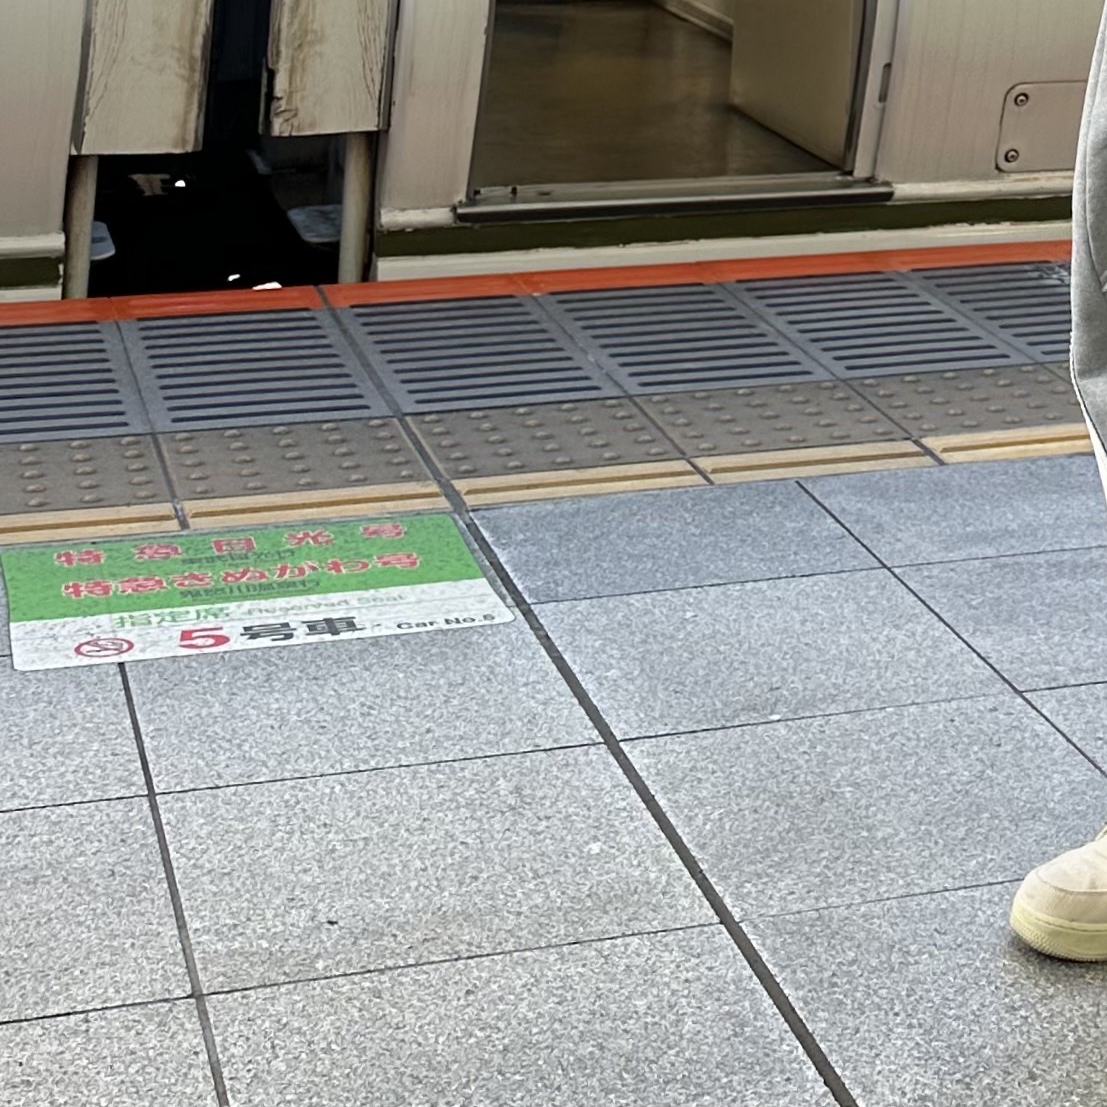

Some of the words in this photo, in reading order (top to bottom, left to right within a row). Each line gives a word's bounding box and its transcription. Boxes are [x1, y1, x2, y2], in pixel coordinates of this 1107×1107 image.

[61, 552, 421, 599] 特急きぬがわ号
[113, 606, 231, 629] 指定席
[396, 620, 439, 630] Car
